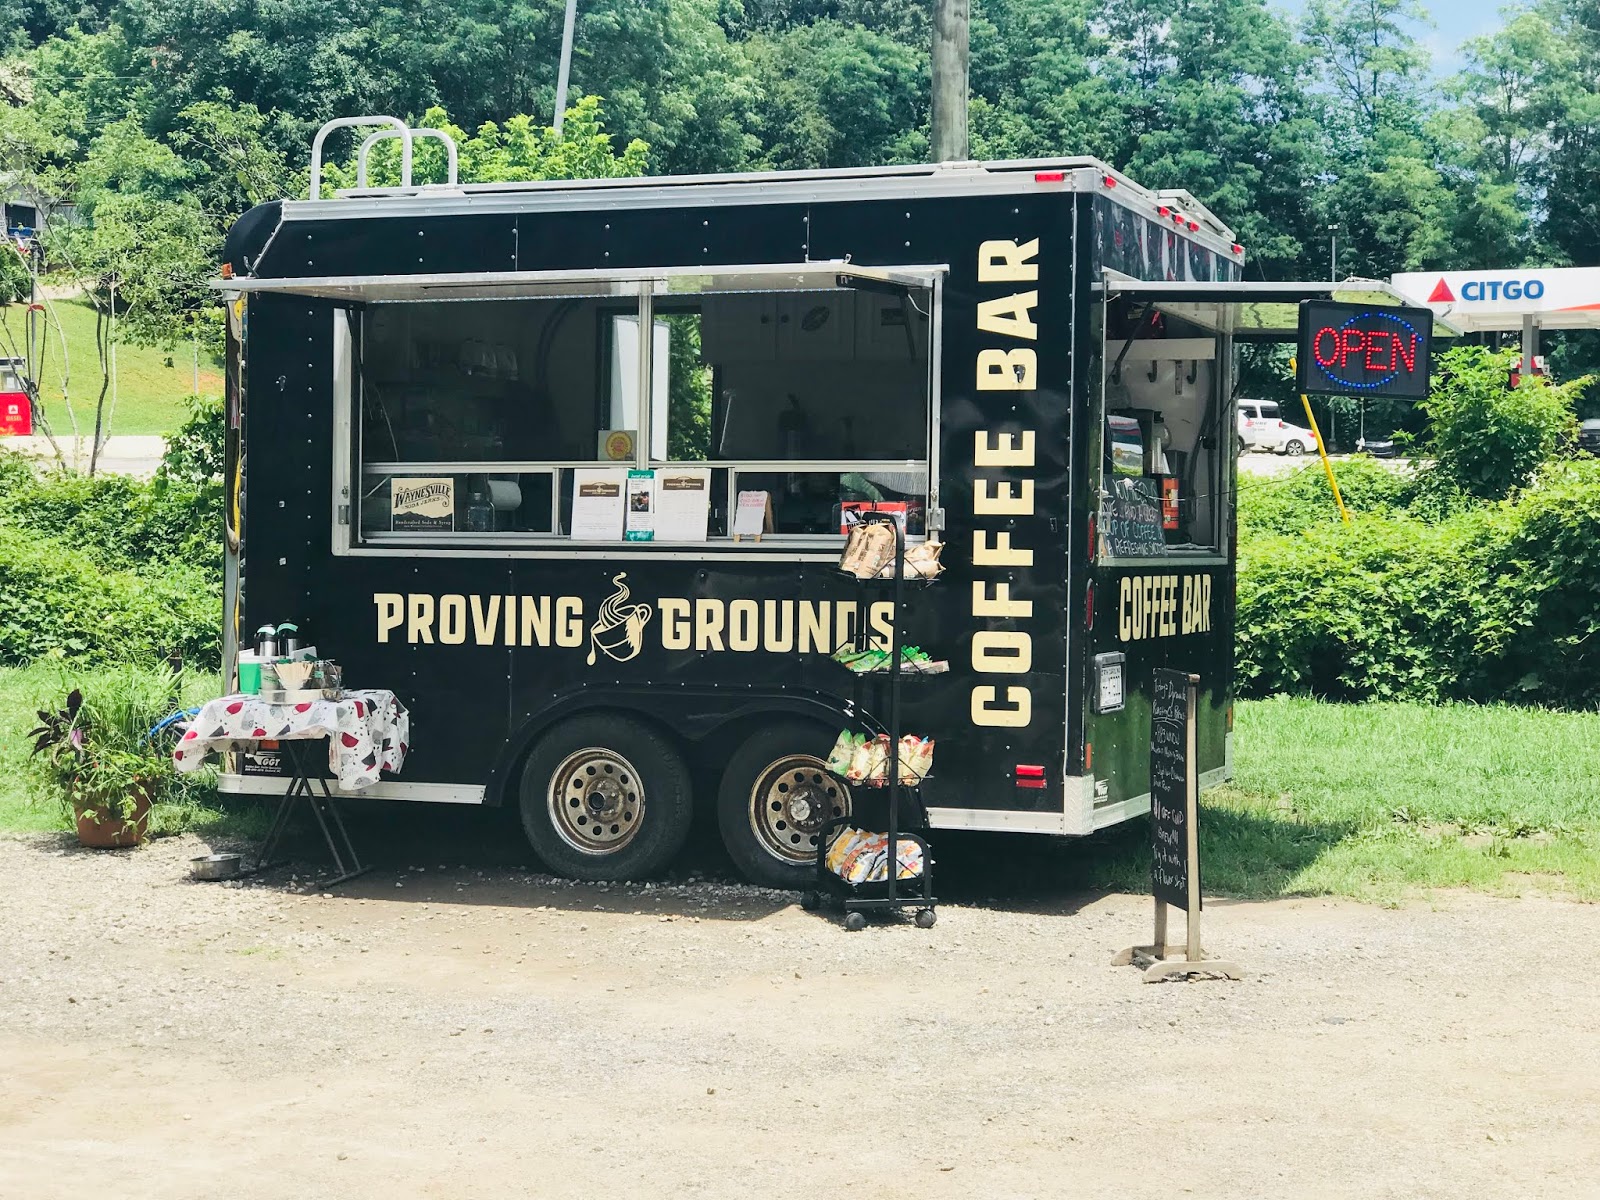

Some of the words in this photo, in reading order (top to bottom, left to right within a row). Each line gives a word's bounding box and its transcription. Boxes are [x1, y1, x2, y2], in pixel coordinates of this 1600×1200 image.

[1461, 280, 1544, 301] CITGO
[976, 237, 1039, 390] BAR
[1314, 327, 1416, 372] OPEN
[394, 484, 451, 508] WAYNESVILLE
[421, 497, 440, 505] JERKS
[1121, 519, 1129, 538] OF
[1133, 521, 1155, 541] COFFEE
[971, 430, 1035, 727] COFFEE
[374, 593, 583, 647] PROVING
[658, 598, 895, 654] GROUNDS
[1120, 575, 1178, 641] COFFEE
[1182, 574, 1211, 635] BAR
[262, 758, 280, 766] GGT
